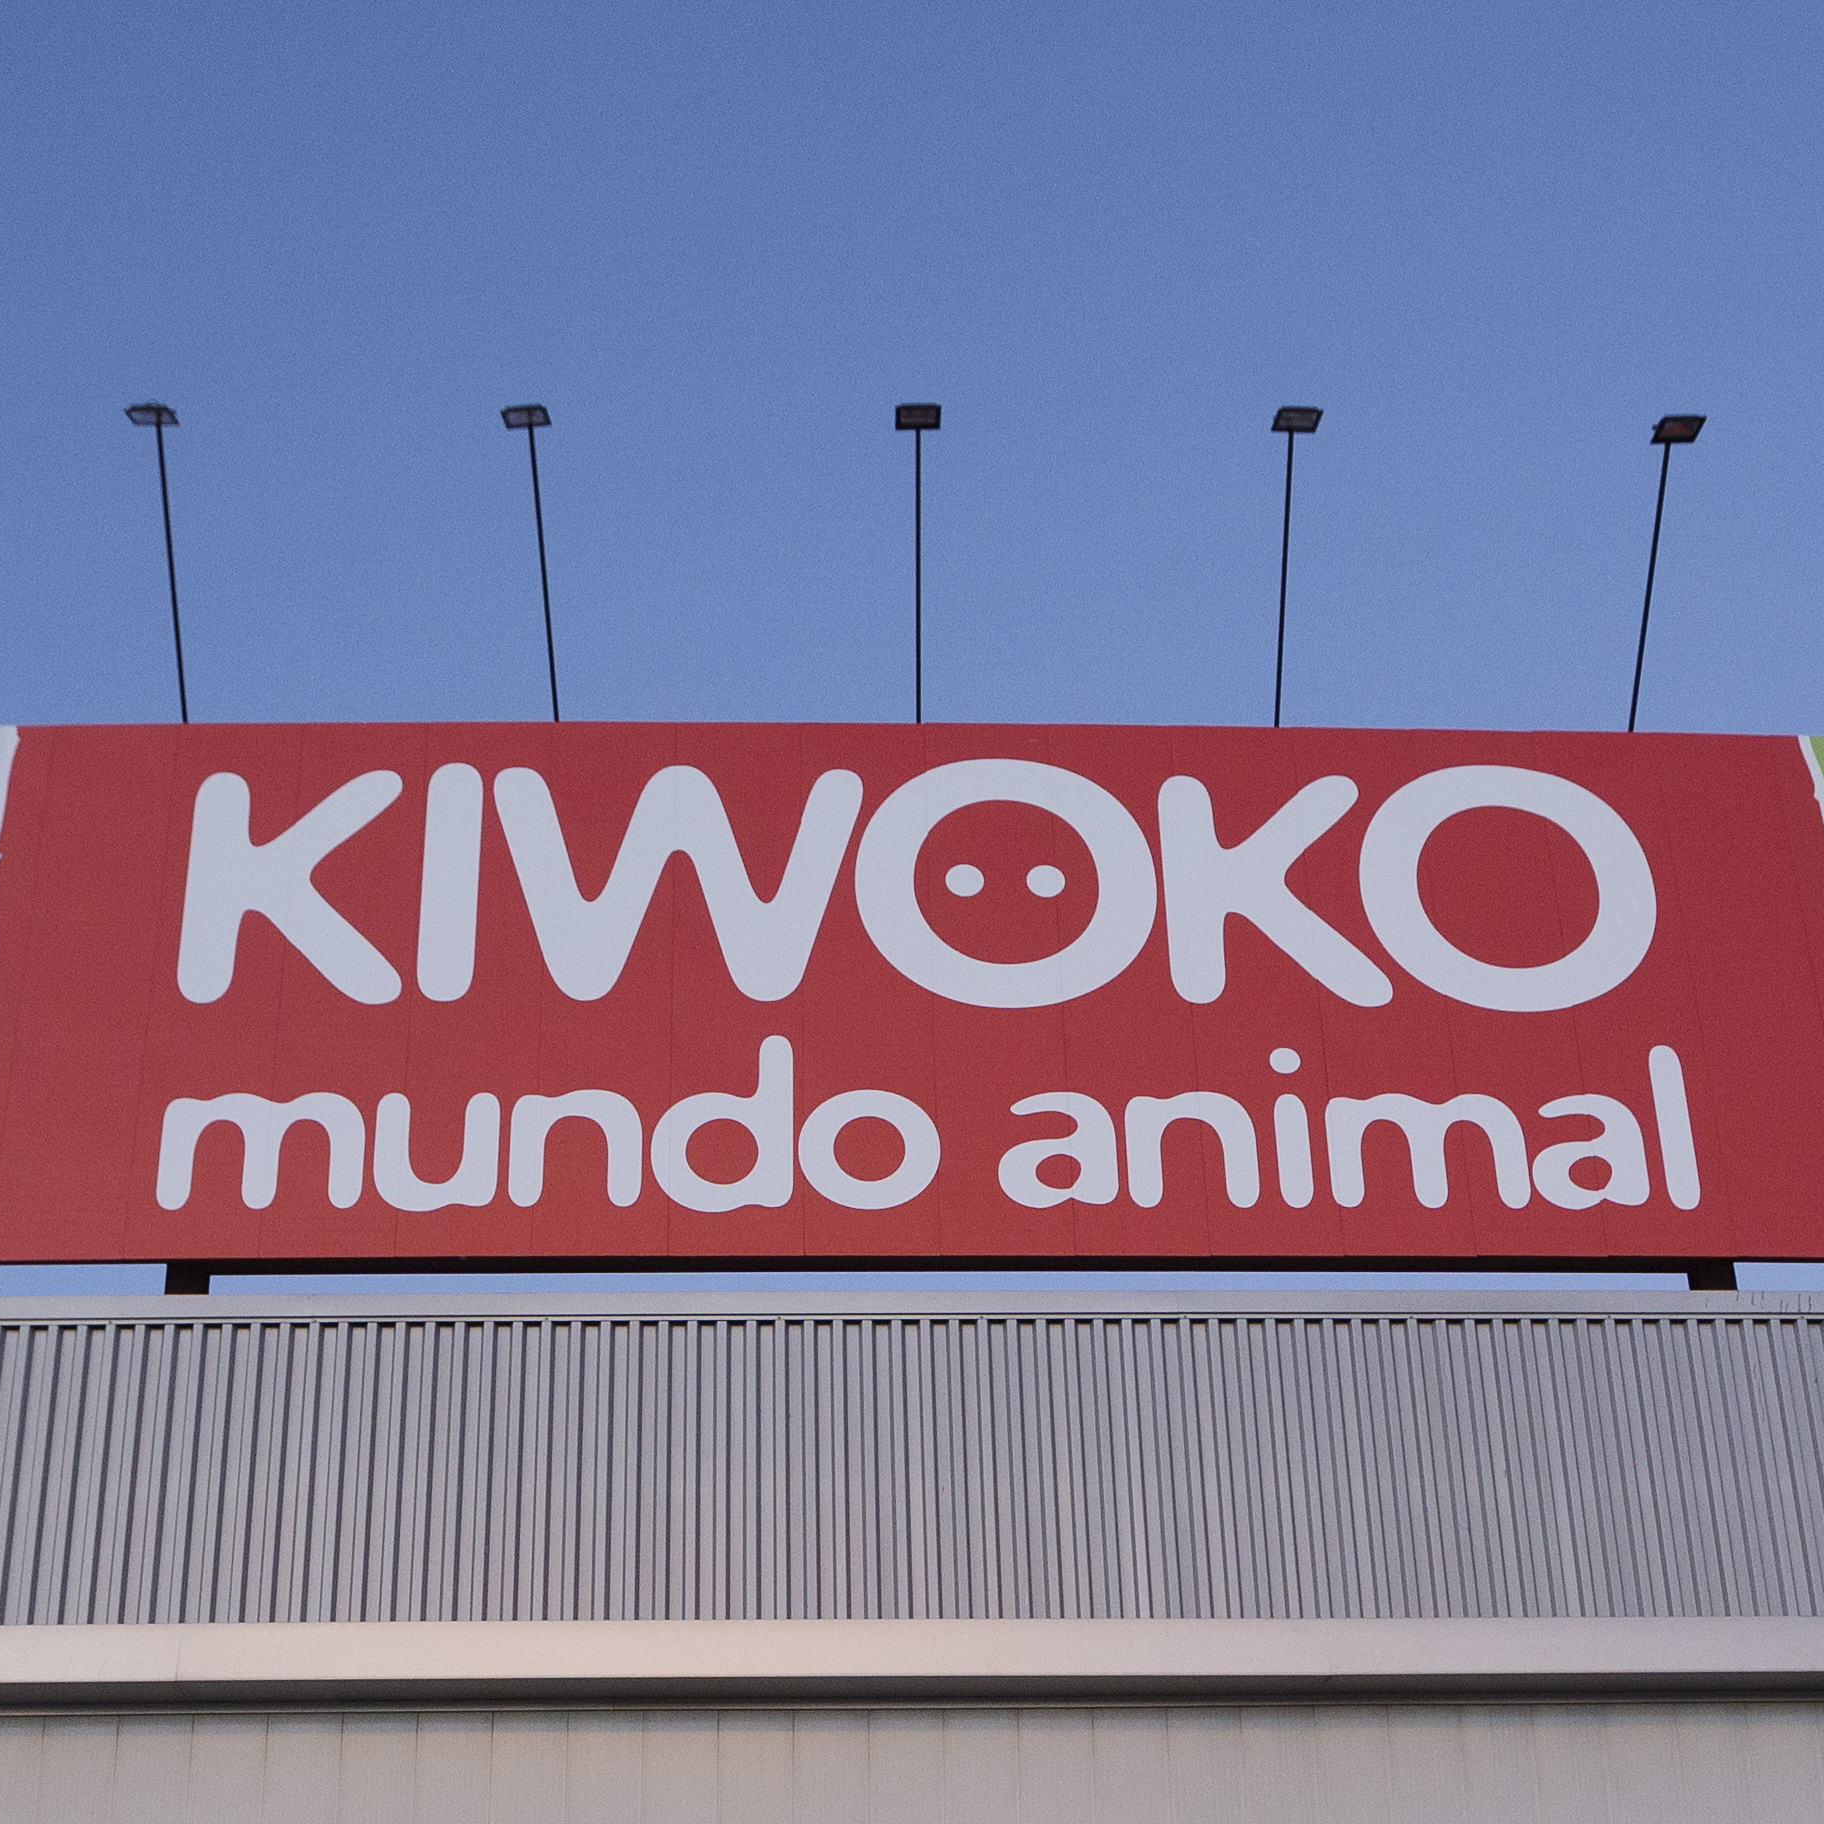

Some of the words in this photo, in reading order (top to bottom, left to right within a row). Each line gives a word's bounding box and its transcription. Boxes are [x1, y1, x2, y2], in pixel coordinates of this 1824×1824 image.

[176, 759, 1658, 1012] KIWOKO
[156, 1034, 940, 1213] mundo
[998, 1046, 1701, 1210] animal
